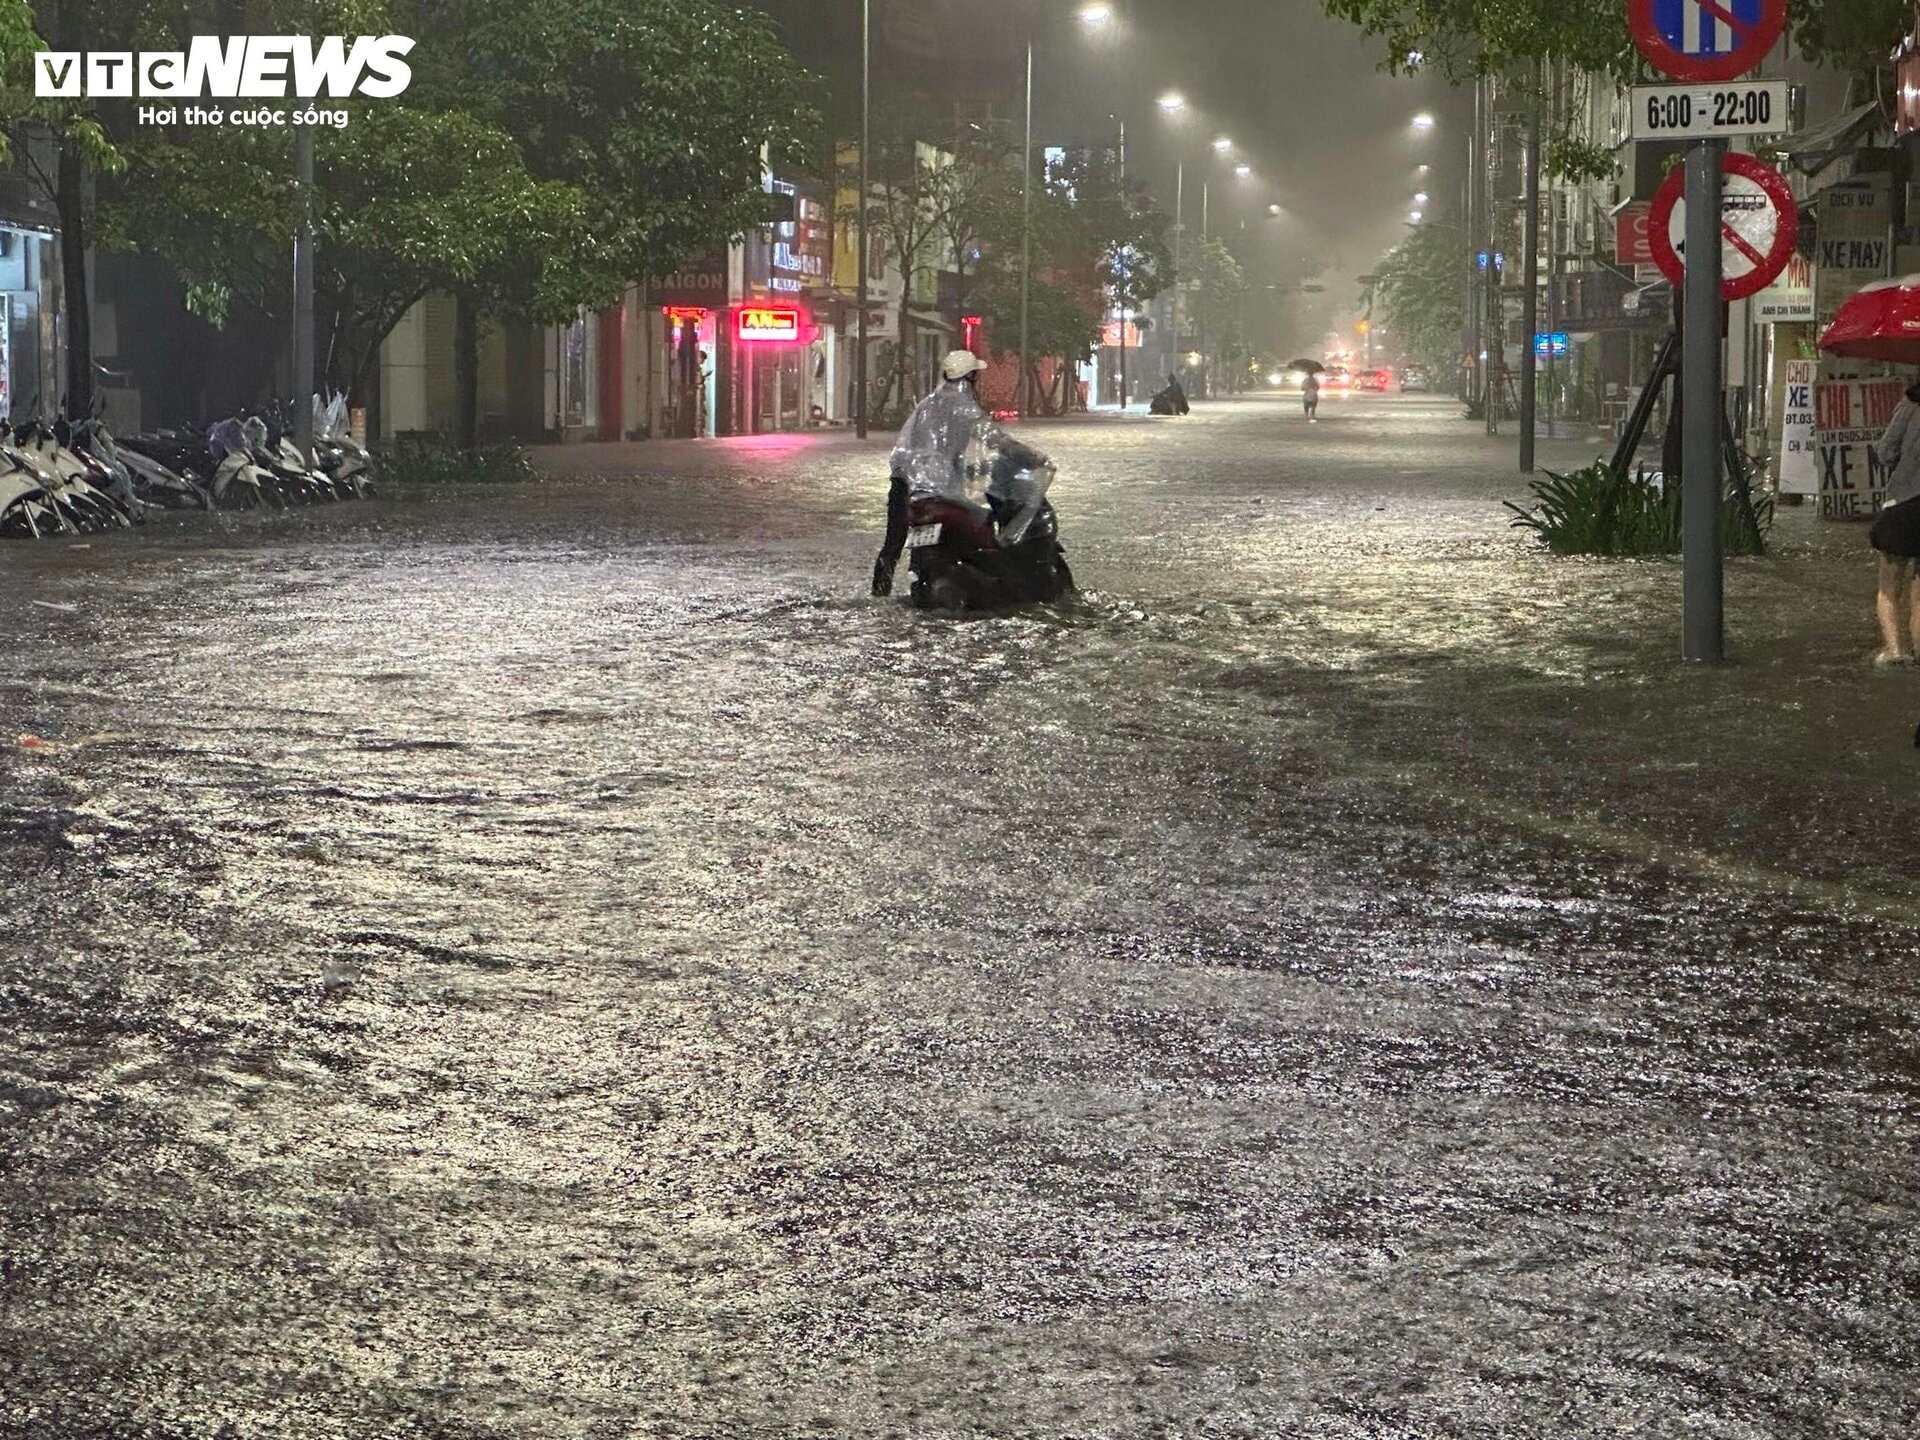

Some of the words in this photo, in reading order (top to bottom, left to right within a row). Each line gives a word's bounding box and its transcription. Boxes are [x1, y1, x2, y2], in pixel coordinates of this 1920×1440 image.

[1647, 94, 1691, 129] 6:00
[1713, 90, 1770, 126] 22:00
[1822, 240, 1846, 269] XE
[1789, 386, 1809, 407] XE
[1820, 445, 1855, 490] XE
